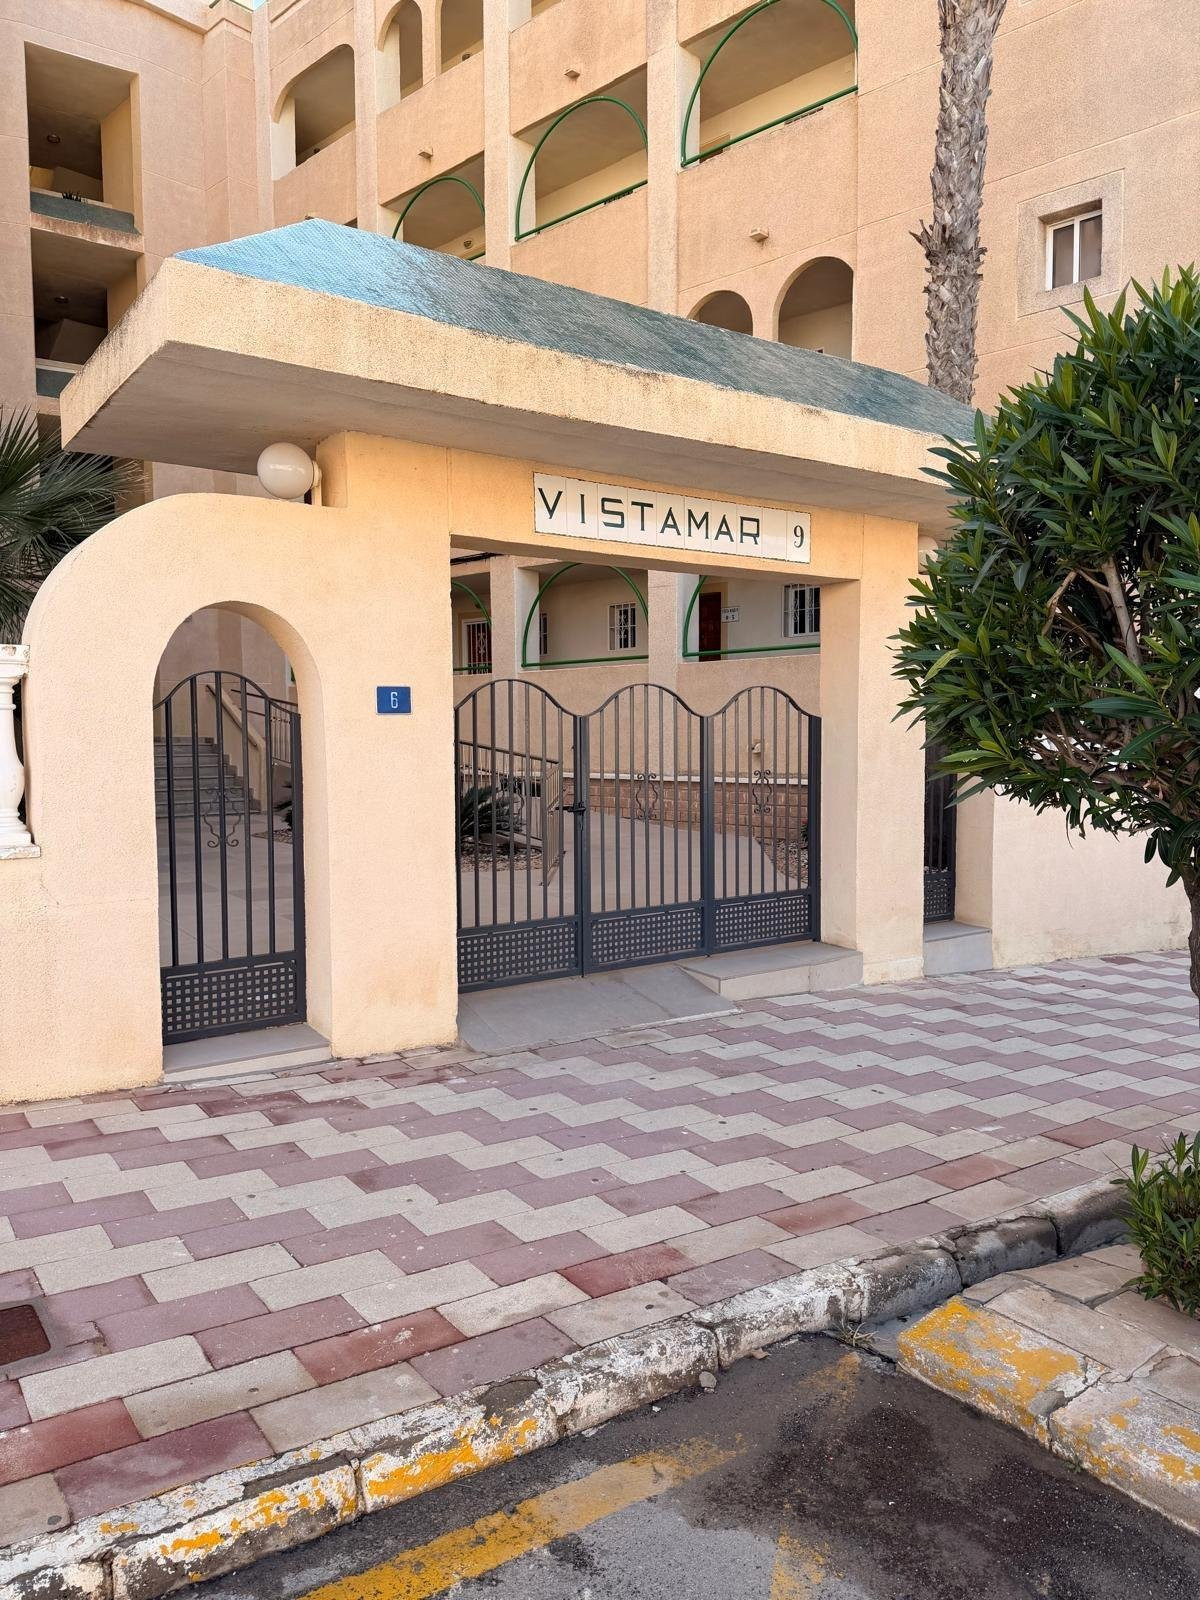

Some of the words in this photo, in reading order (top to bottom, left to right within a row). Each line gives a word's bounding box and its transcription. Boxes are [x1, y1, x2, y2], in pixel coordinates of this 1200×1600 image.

[538, 487, 760, 545] VISTAMAR
[793, 524, 805, 548] 9
[390, 691, 398, 709] 6
